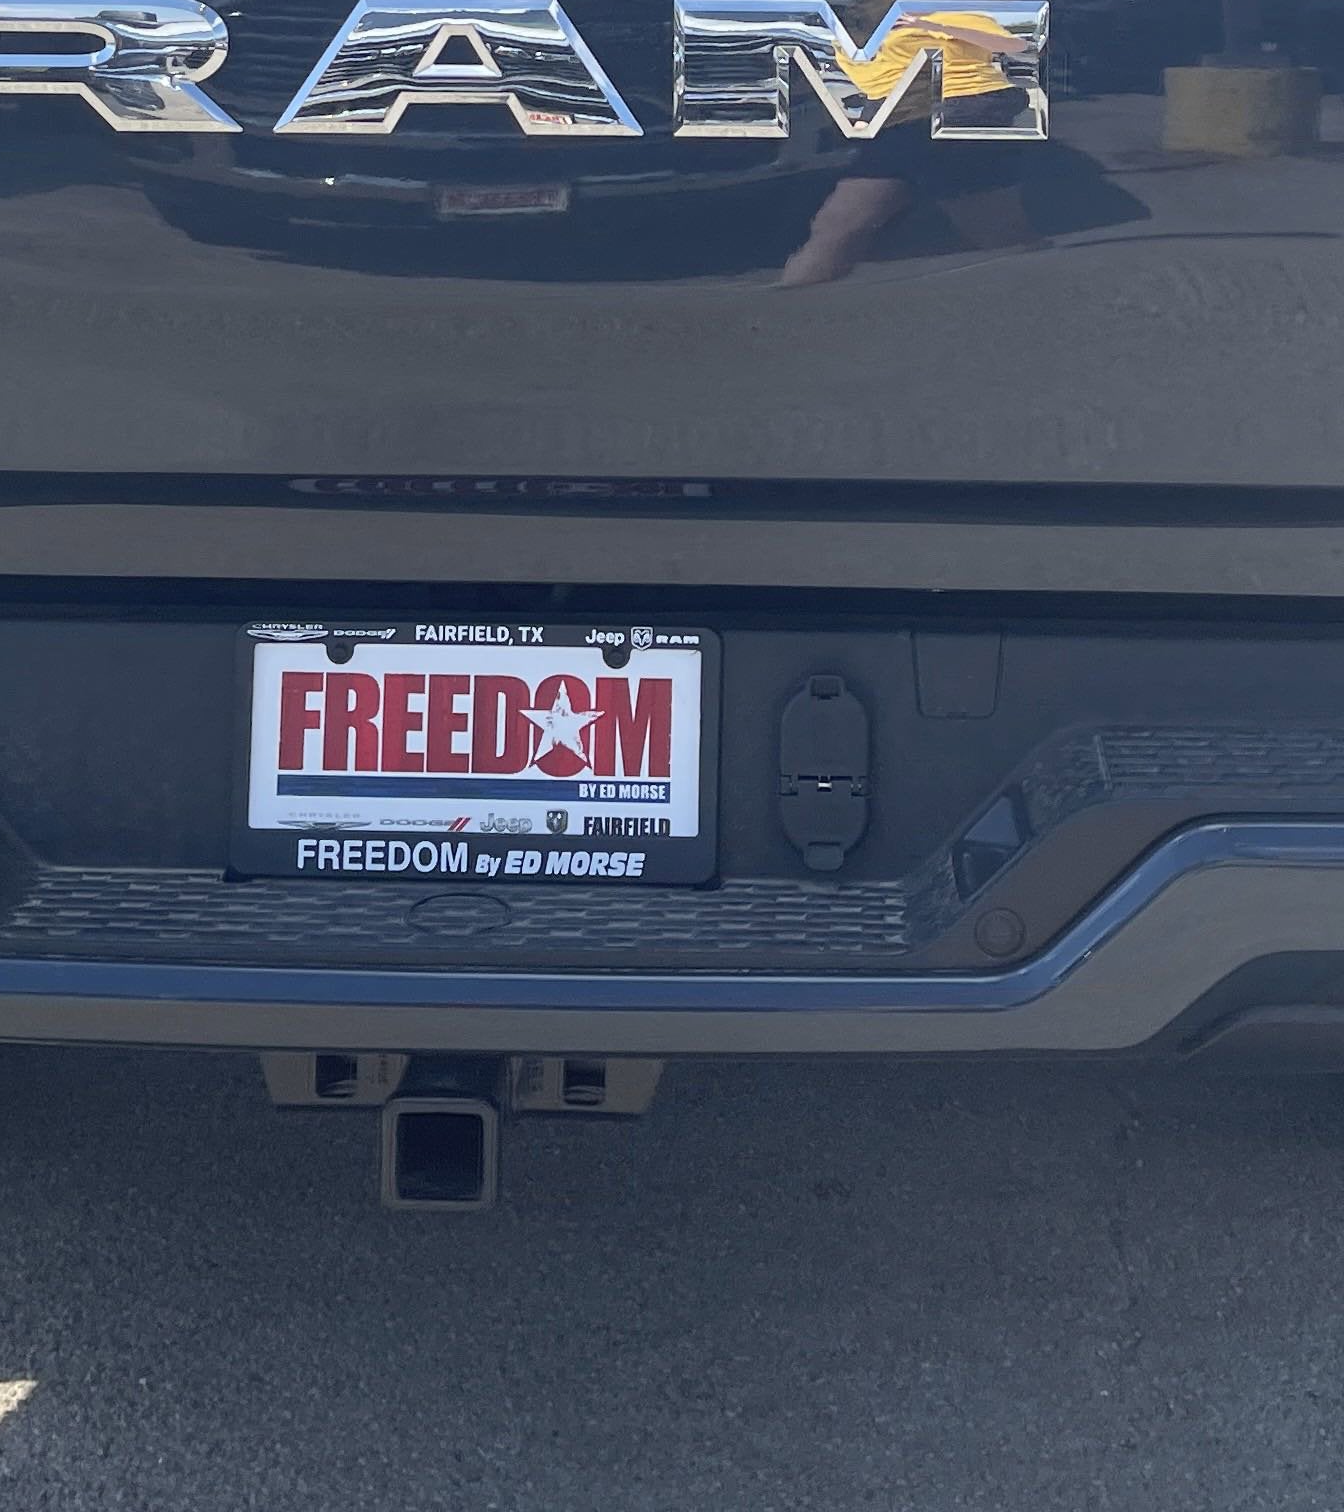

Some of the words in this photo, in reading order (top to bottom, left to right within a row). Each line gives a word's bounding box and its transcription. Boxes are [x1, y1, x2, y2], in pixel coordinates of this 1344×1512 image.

[415, 624, 514, 645] FAIRFIELD,
[518, 626, 544, 643] TX
[585, 629, 625, 646] Jeep
[656, 635, 700, 645] RAM
[278, 671, 673, 778] FREEDOM
[578, 783, 596, 798] BY
[599, 784, 616, 798] ED
[619, 785, 666, 800] MORSE
[480, 813, 533, 833] Jeep
[583, 816, 671, 837] FAIRFIELD
[297, 839, 468, 873] FREEDOM
[475, 854, 502, 876] By
[504, 850, 541, 875] ED
[544, 852, 647, 877] MORSE
